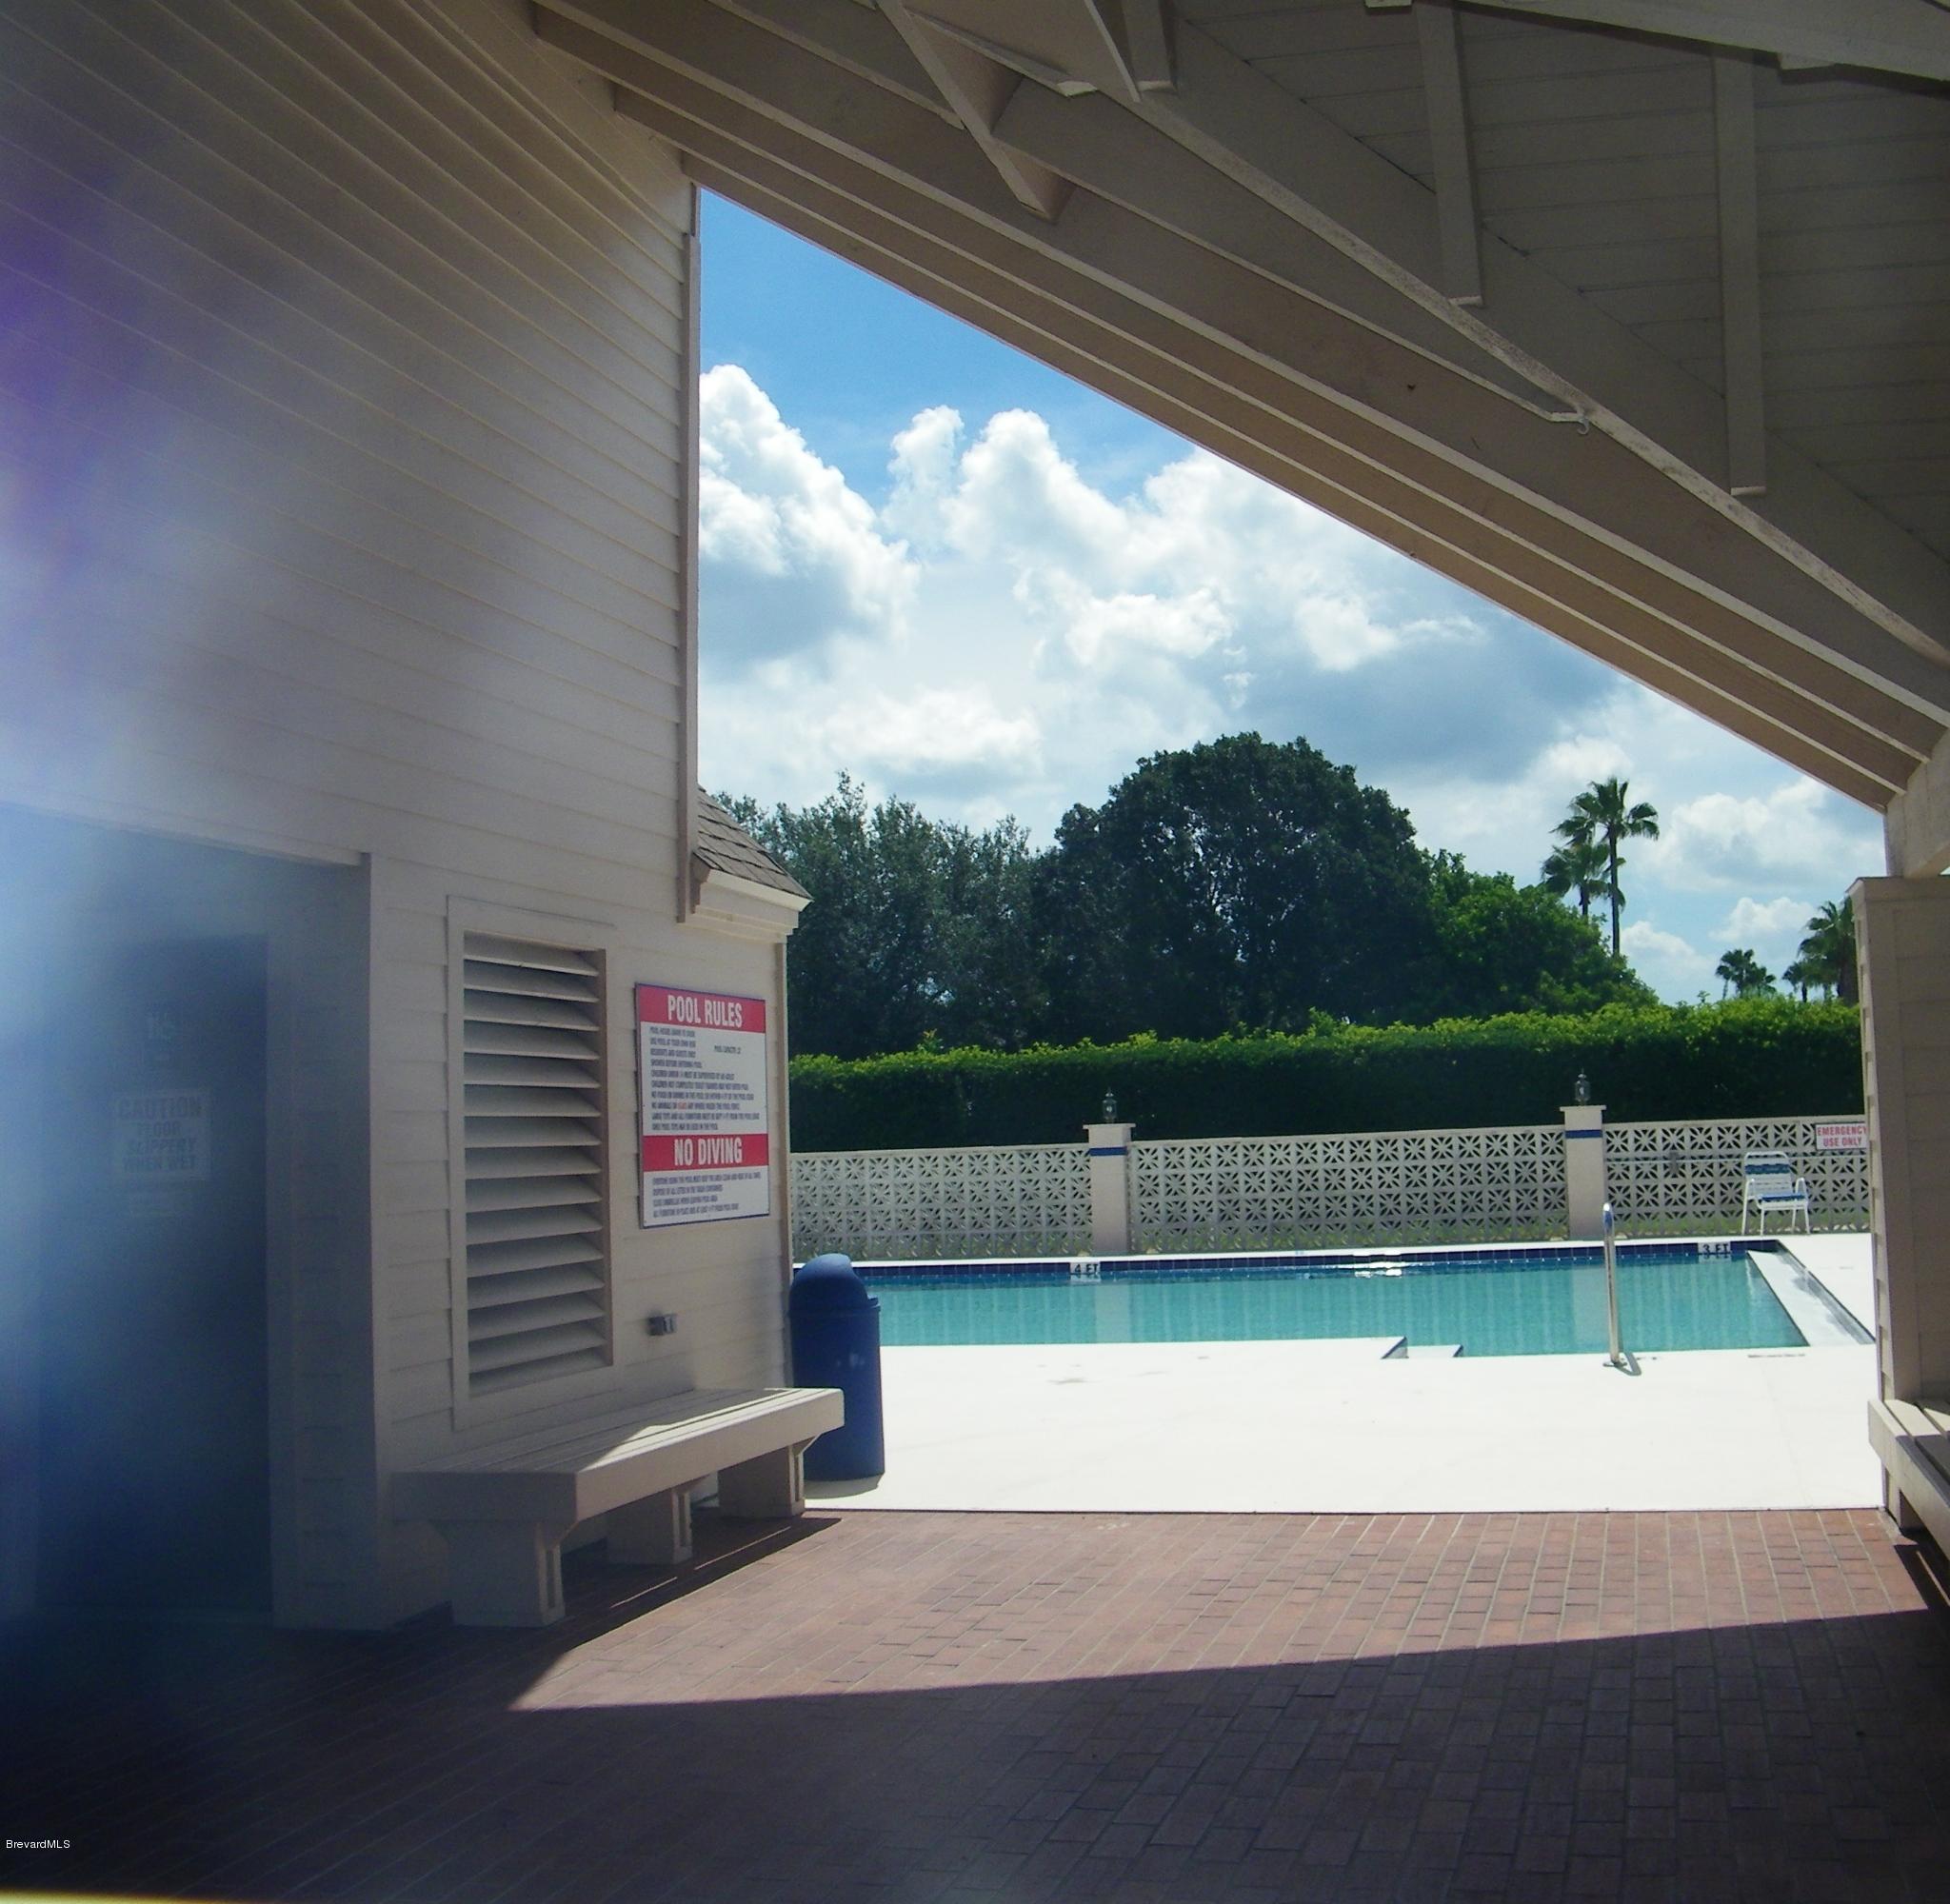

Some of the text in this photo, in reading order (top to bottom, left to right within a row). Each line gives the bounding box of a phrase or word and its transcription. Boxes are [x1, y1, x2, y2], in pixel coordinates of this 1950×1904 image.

[667, 994, 743, 1028] POOL RULES
[119, 1096, 202, 1120] CAUTION
[1817, 1125, 1867, 1136] EMERGENCY
[1822, 1136, 1862, 1147] USE ONLY
[673, 1137, 743, 1166] NO DIVING
[1702, 1242, 1728, 1254] 3 FT
[1074, 1263, 1099, 1273] 4 FT
